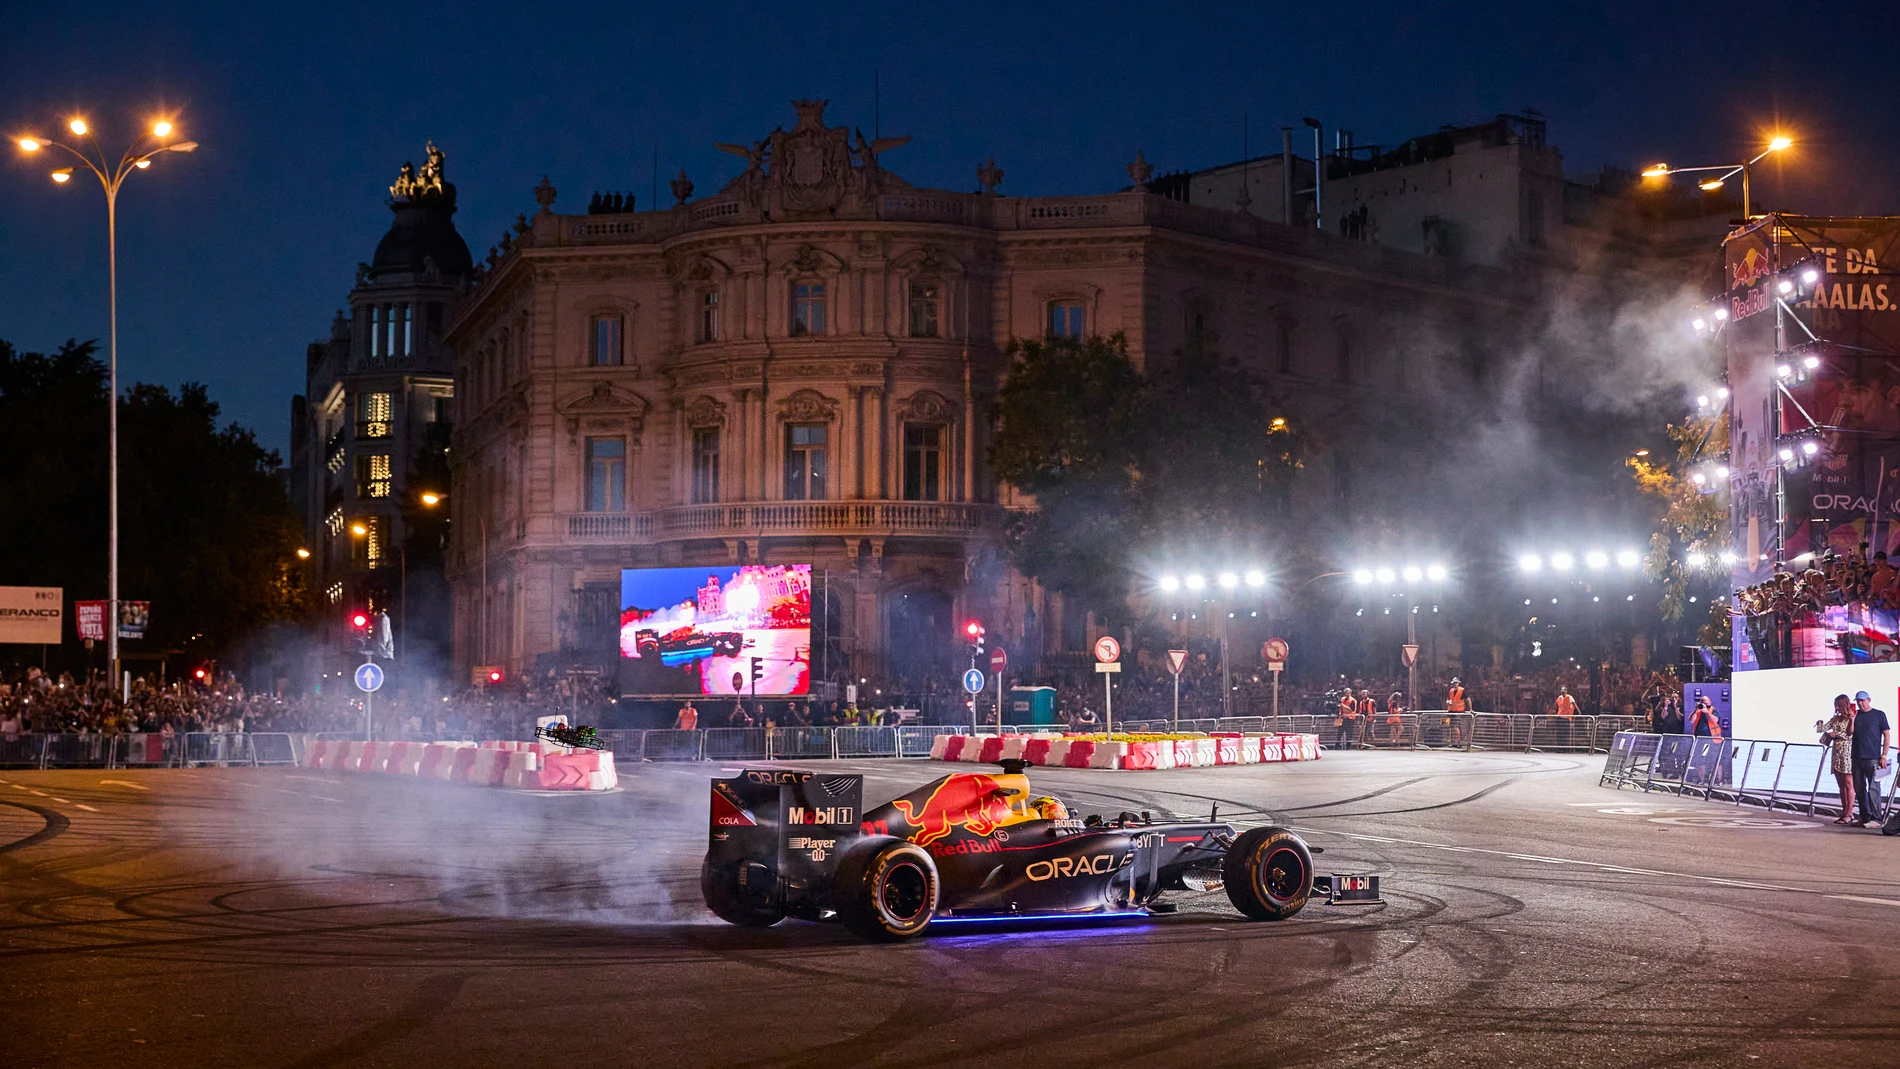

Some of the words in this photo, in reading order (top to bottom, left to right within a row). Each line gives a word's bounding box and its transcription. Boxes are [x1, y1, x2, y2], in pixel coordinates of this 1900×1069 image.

[1846, 248, 1879, 274] DA
[1795, 282, 1897, 311] AALAS.
[718, 817, 739, 825] COLA
[788, 807, 835, 825] Mobil
[1054, 819, 1078, 828] ROKT
[800, 837, 836, 851] Player
[1026, 853, 1135, 881] ORACLE
[1341, 877, 1370, 891] Mobil
